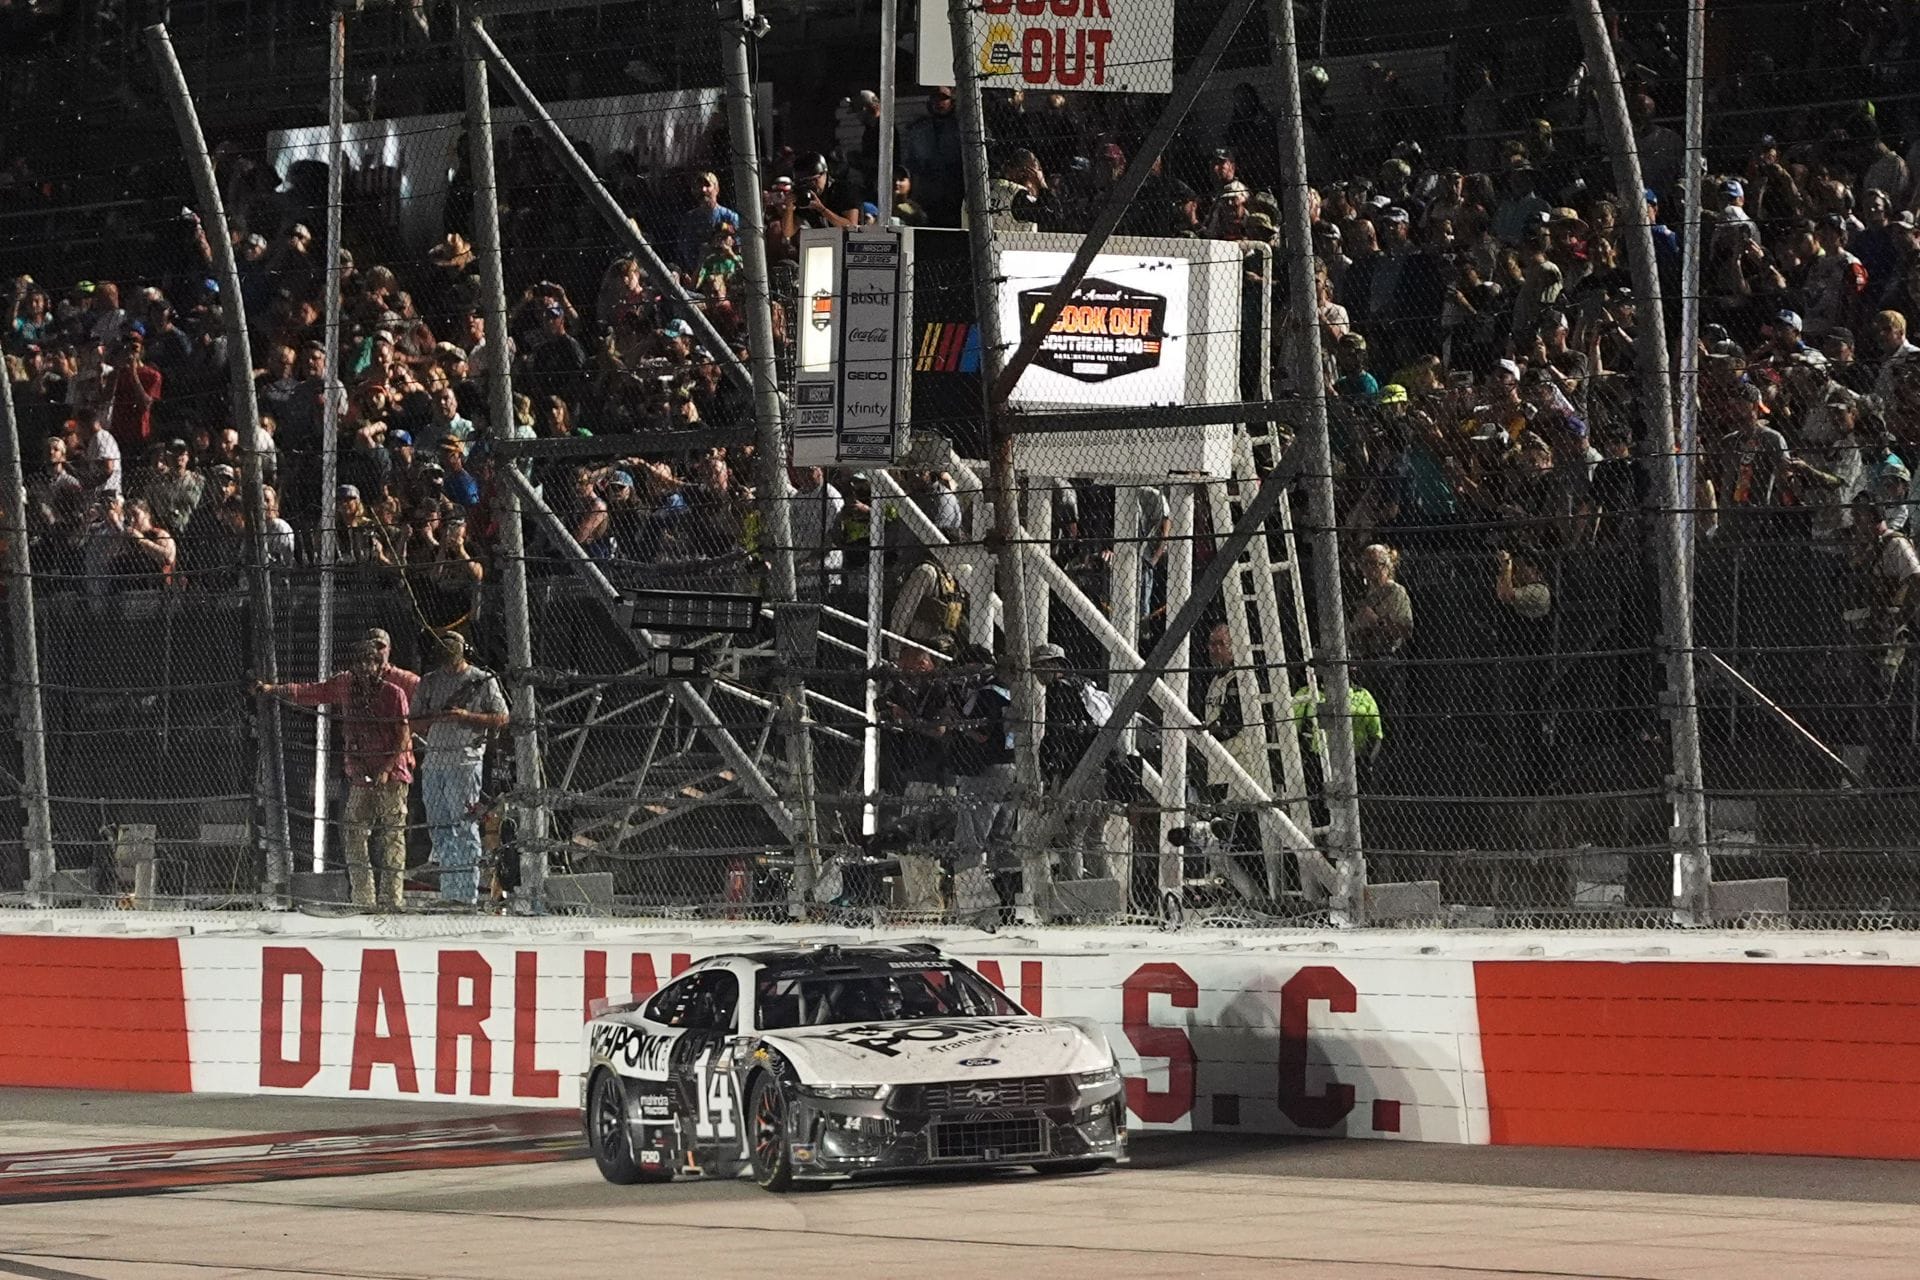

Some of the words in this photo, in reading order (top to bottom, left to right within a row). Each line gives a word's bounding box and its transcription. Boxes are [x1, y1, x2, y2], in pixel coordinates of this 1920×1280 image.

[1021, 27, 1113, 86] OUT
[850, 292, 889, 306] BUSCH
[1109, 307, 1152, 336] OUT
[1039, 334, 1114, 354] SOUTHERN
[1115, 337, 1143, 355] 500
[847, 371, 888, 381] GEICO
[847, 401, 888, 417] xfinity
[888, 960, 954, 970] BRISCOE
[694, 1047, 738, 1138] 14
[843, 1116, 862, 1131] 14
